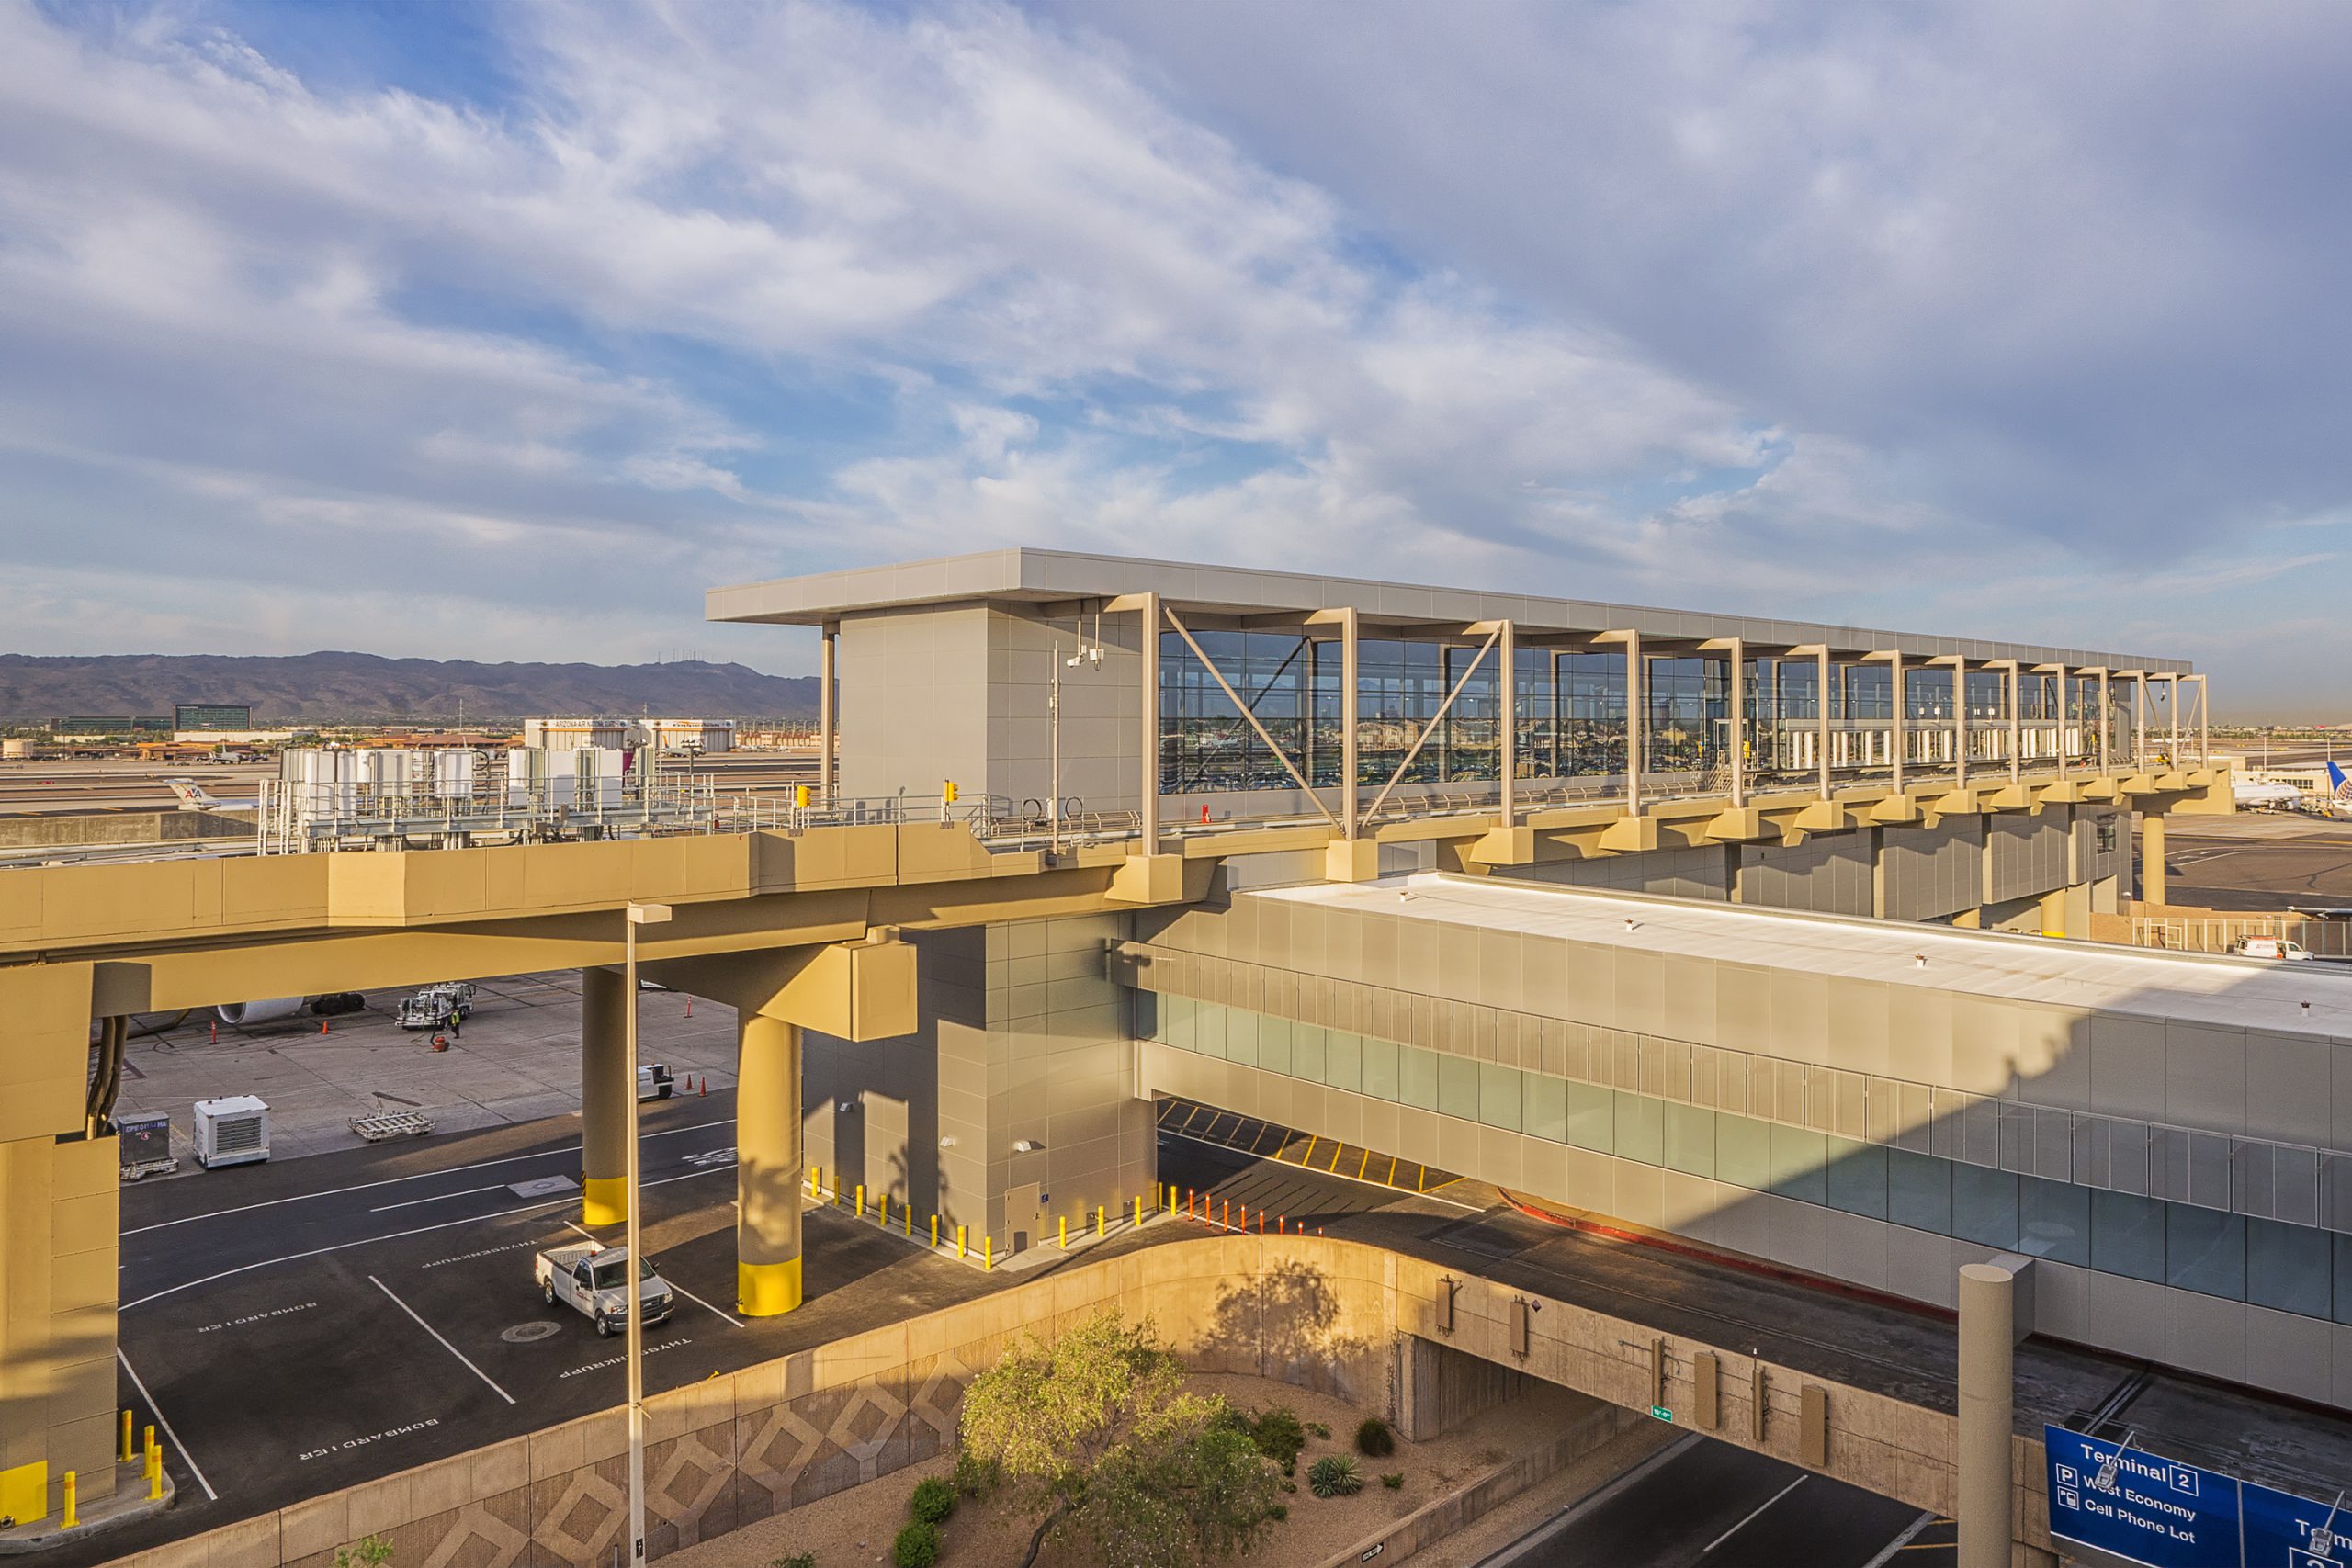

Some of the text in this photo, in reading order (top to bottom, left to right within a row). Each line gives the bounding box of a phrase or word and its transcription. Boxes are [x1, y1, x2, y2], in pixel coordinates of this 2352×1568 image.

[422, 1240, 538, 1269] THYSSENKRUPP
[560, 1337, 693, 1379] THYSSNKRUPP
[299, 1417, 440, 1461] BOMBARDIER
[2080, 1443, 2190, 1488] Terminal 2
[2085, 1499, 2196, 1544] Cell Phone Lot
[2125, 1488, 2197, 1522] Economy
